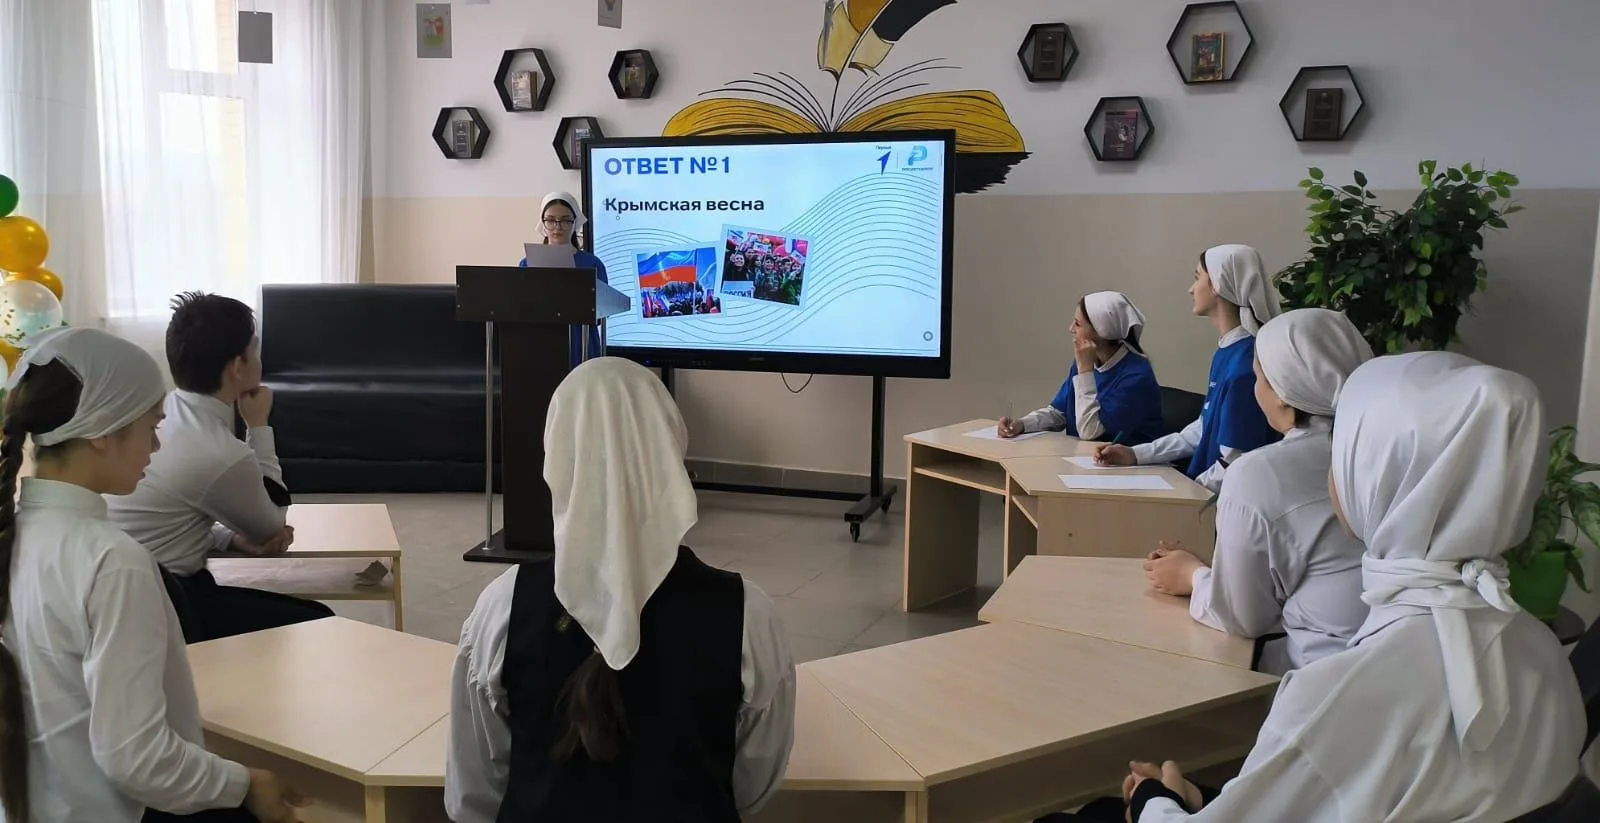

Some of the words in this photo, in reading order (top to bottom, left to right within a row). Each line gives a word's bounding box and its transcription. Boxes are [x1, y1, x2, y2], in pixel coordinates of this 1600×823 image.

[604, 157, 684, 175] ОТВЕТ
[605, 197, 701, 213] Крымская
[706, 199, 765, 211] весна
